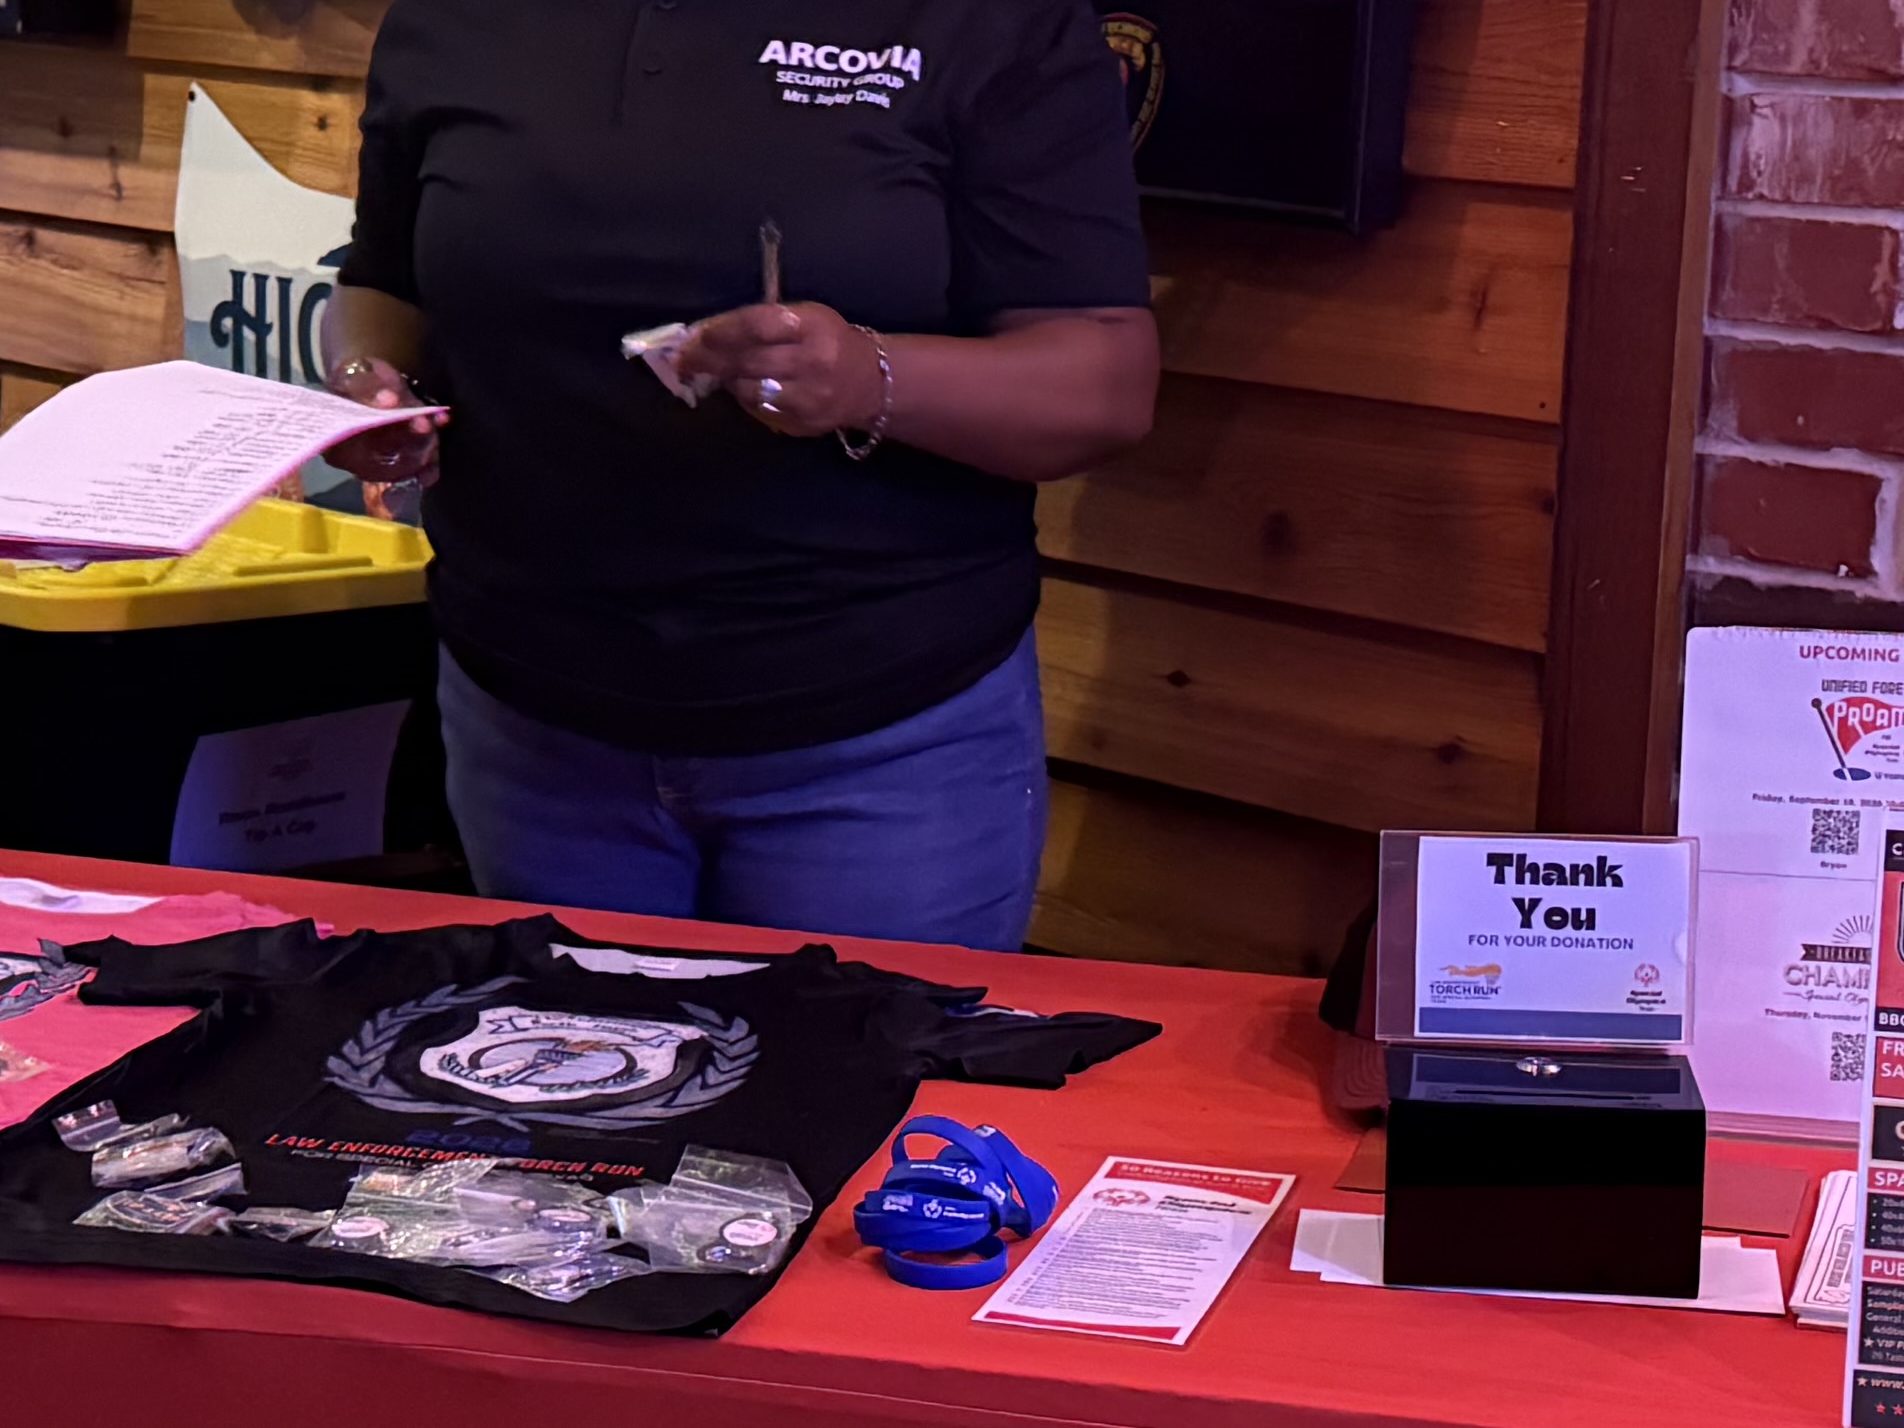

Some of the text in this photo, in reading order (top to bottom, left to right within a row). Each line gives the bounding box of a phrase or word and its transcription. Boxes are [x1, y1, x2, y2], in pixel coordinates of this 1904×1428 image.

[758, 40, 922, 82] ARCOVIA
[776, 70, 905, 89] SECURITY GROUP
[1799, 645, 1900, 663] UPCOMING
[1821, 679, 1868, 693] UNIFIED
[1872, 681, 1904, 695] FORE
[1486, 852, 1624, 889] Thank
[1510, 897, 1597, 932] You
[1467, 933, 1634, 951] FOR YOUR DONATION
[1429, 984, 1471, 996] TORCH
[264, 1133, 645, 1177] LAW ENFORCEMEN ORCH RUN
